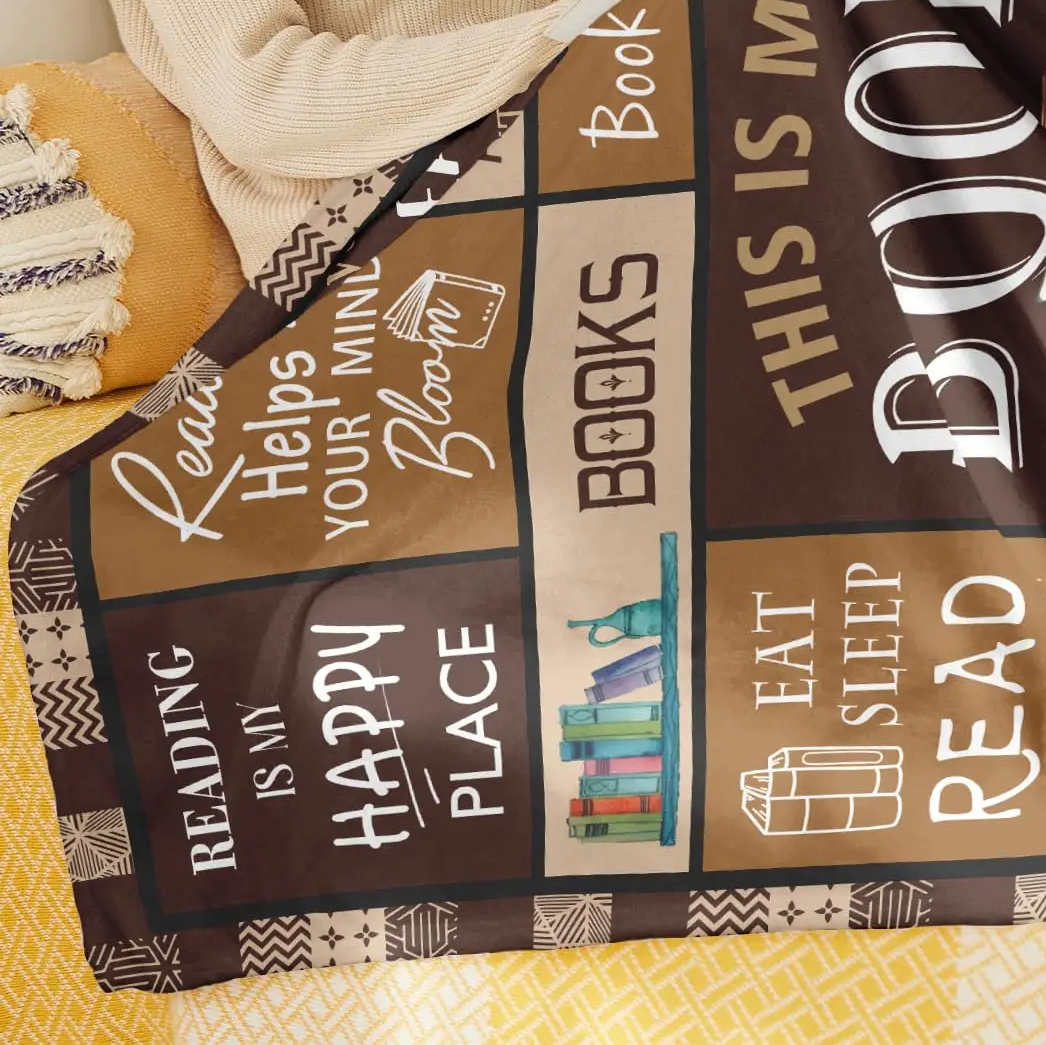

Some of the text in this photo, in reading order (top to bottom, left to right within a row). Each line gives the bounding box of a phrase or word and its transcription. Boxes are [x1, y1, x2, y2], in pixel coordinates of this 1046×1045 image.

[578, 9, 660, 148] Book
[734, 114, 812, 192] IS
[376, 297, 495, 478] Bloom
[574, 252, 658, 513] BOOKS
[737, 225, 854, 427] THIS
[241, 350, 339, 502] Helps
[325, 413, 371, 540] YOUR
[437, 623, 504, 818] PLACE
[751, 591, 819, 710] EAT
[836, 562, 907, 727] SLEEP
[929, 574, 1040, 823] READ
[147, 645, 237, 875] READING
[236, 701, 296, 800] IS MY
[310, 624, 409, 849] HAPPY
